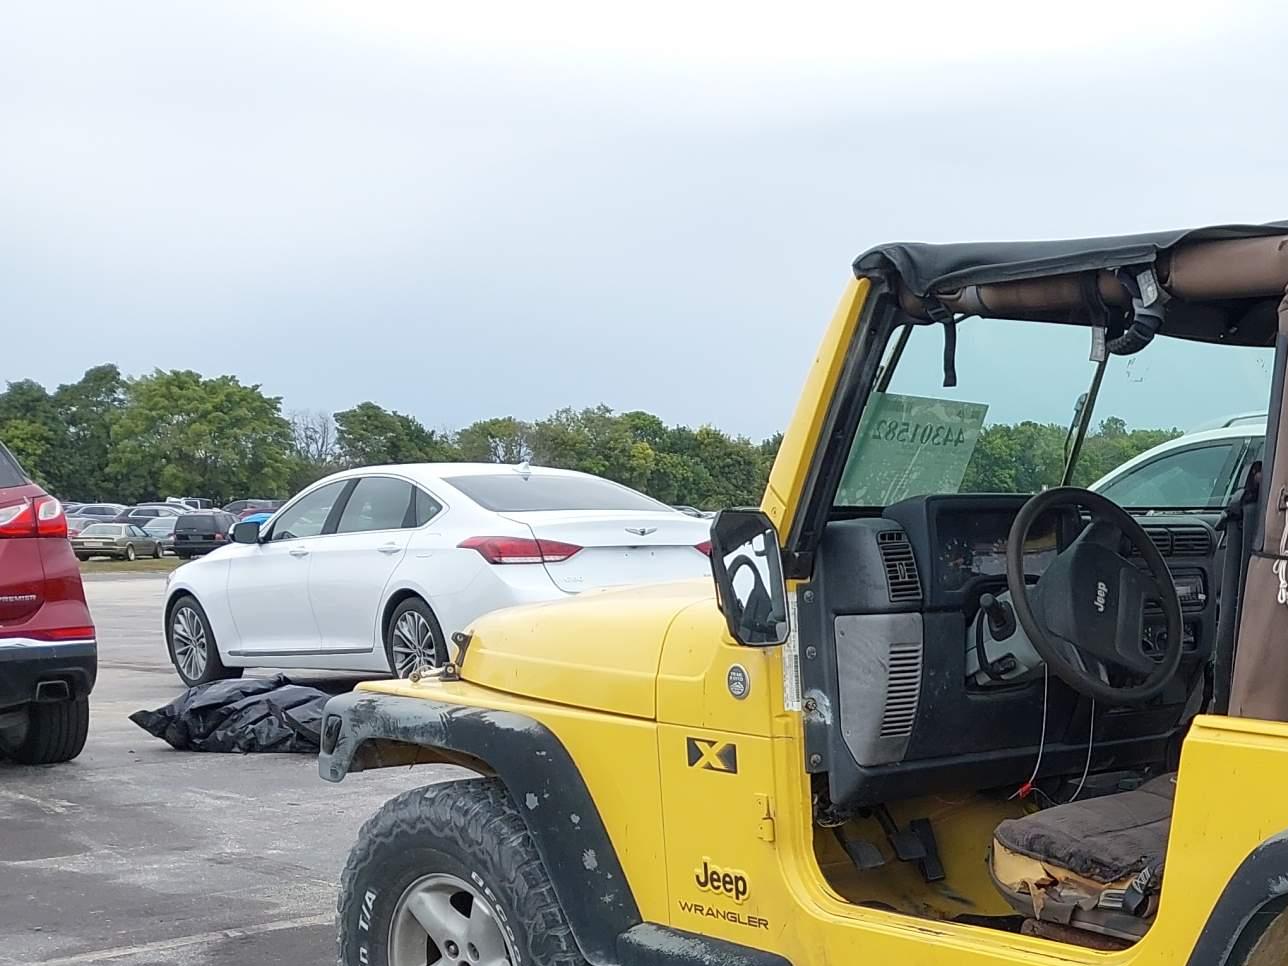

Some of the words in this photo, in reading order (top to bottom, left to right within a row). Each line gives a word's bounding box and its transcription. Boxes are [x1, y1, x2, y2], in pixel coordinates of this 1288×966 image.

[1093, 581, 1109, 613] Jeep
[690, 737, 733, 773] X
[695, 861, 748, 901] Jeep
[358, 889, 378, 932] T/A
[678, 900, 769, 930] WRANGLER
